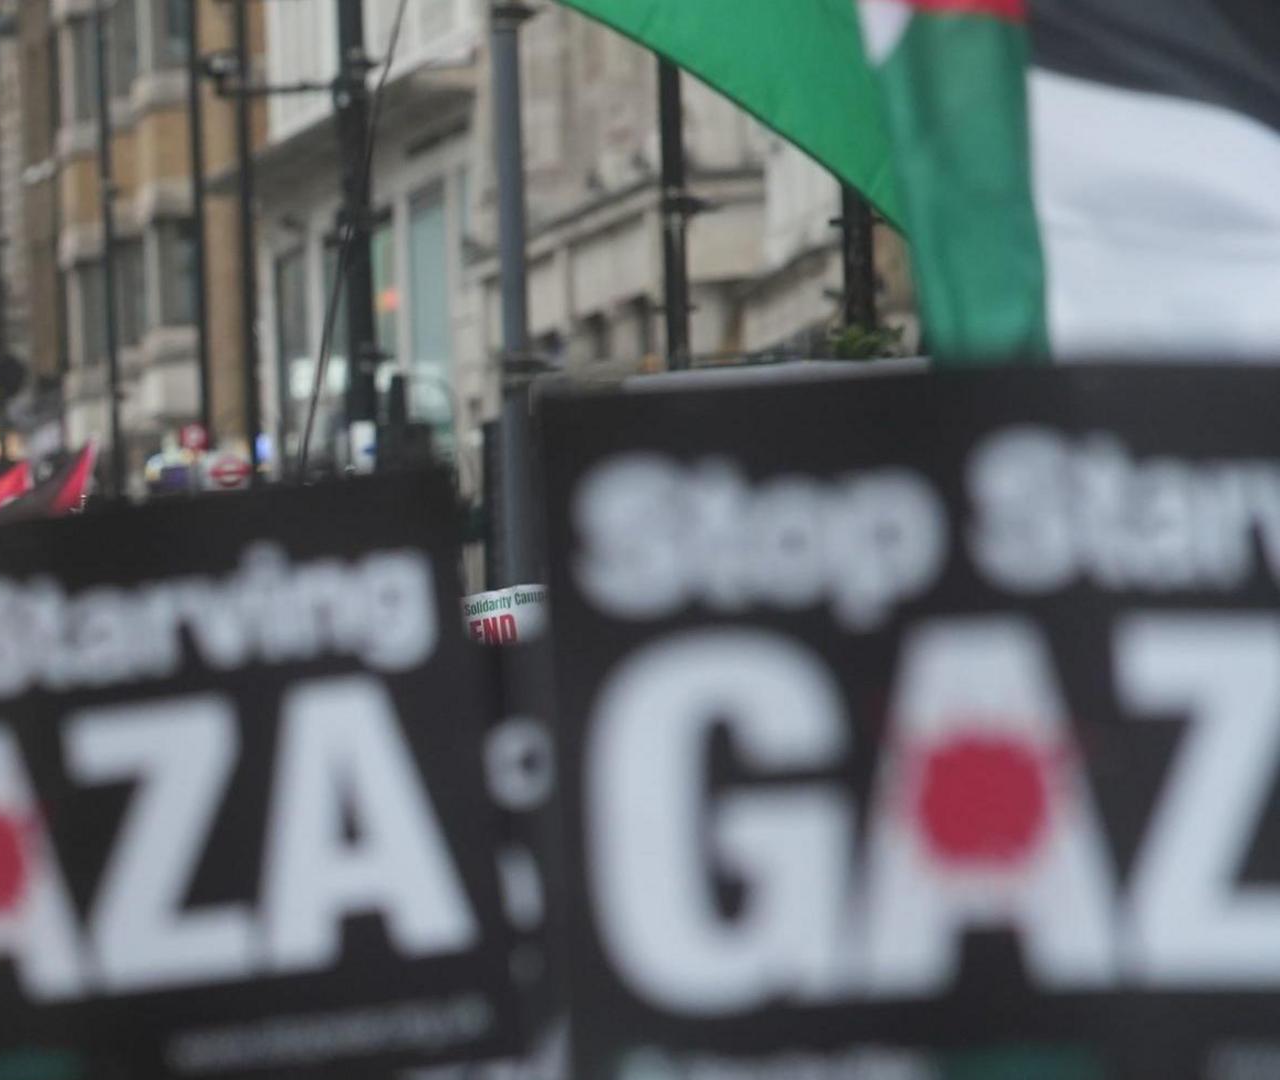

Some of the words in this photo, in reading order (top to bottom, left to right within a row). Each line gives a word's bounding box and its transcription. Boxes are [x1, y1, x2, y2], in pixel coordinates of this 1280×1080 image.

[574, 452, 948, 631] Stop
[967, 424, 1280, 593] Star
[464, 597, 512, 616] Solidarity
[469, 614, 517, 645] END
[583, 610, 1280, 1018] GAZ
